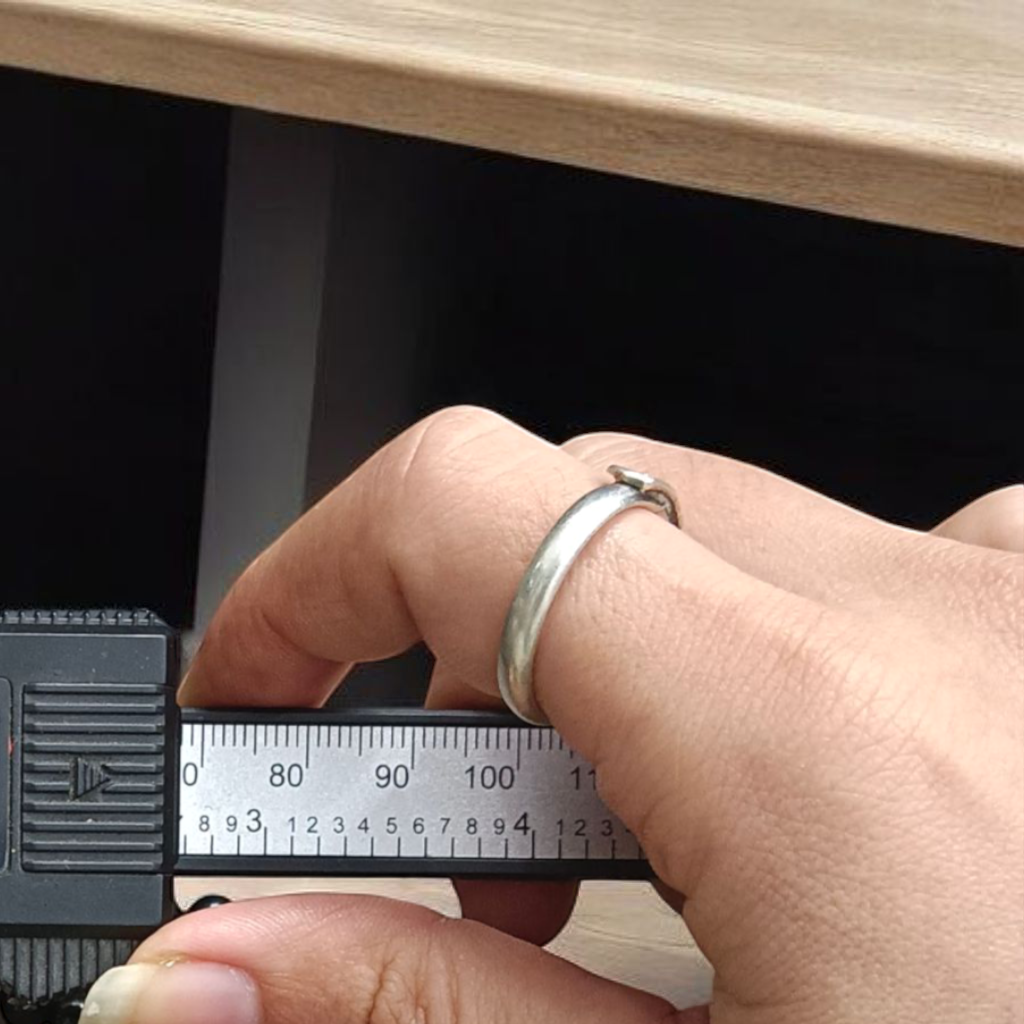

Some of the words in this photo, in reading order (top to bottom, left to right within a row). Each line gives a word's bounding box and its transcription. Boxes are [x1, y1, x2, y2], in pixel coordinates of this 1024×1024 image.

[182, 762, 199, 787] 0
[269, 763, 304, 788] 80
[375, 764, 410, 789] 90
[464, 765, 516, 790] 100
[570, 766, 597, 791] 11
